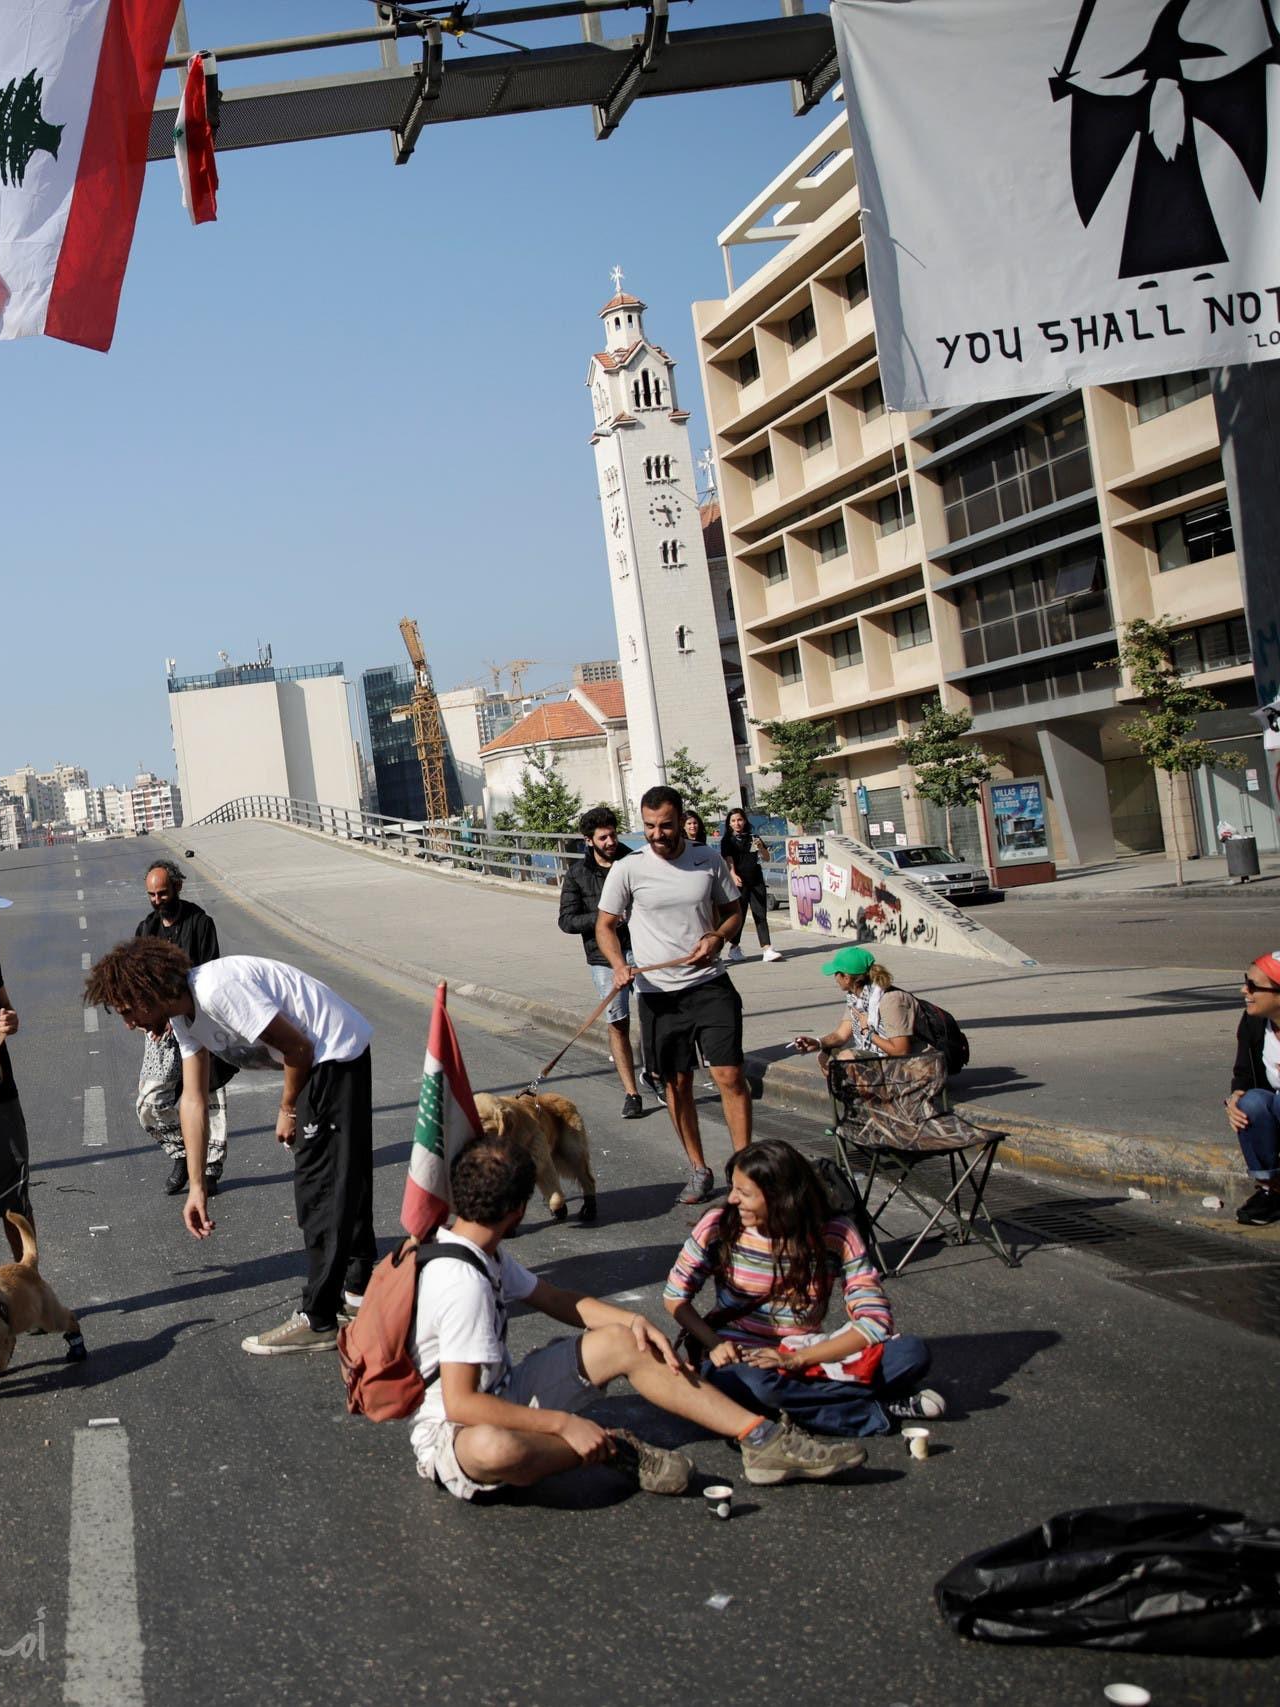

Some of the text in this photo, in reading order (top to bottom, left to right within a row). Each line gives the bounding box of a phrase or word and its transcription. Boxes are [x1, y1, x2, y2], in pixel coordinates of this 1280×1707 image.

[936, 325, 1023, 369] YOU
[1038, 304, 1186, 354] SHALL
[995, 787, 1016, 797] VILLAS
